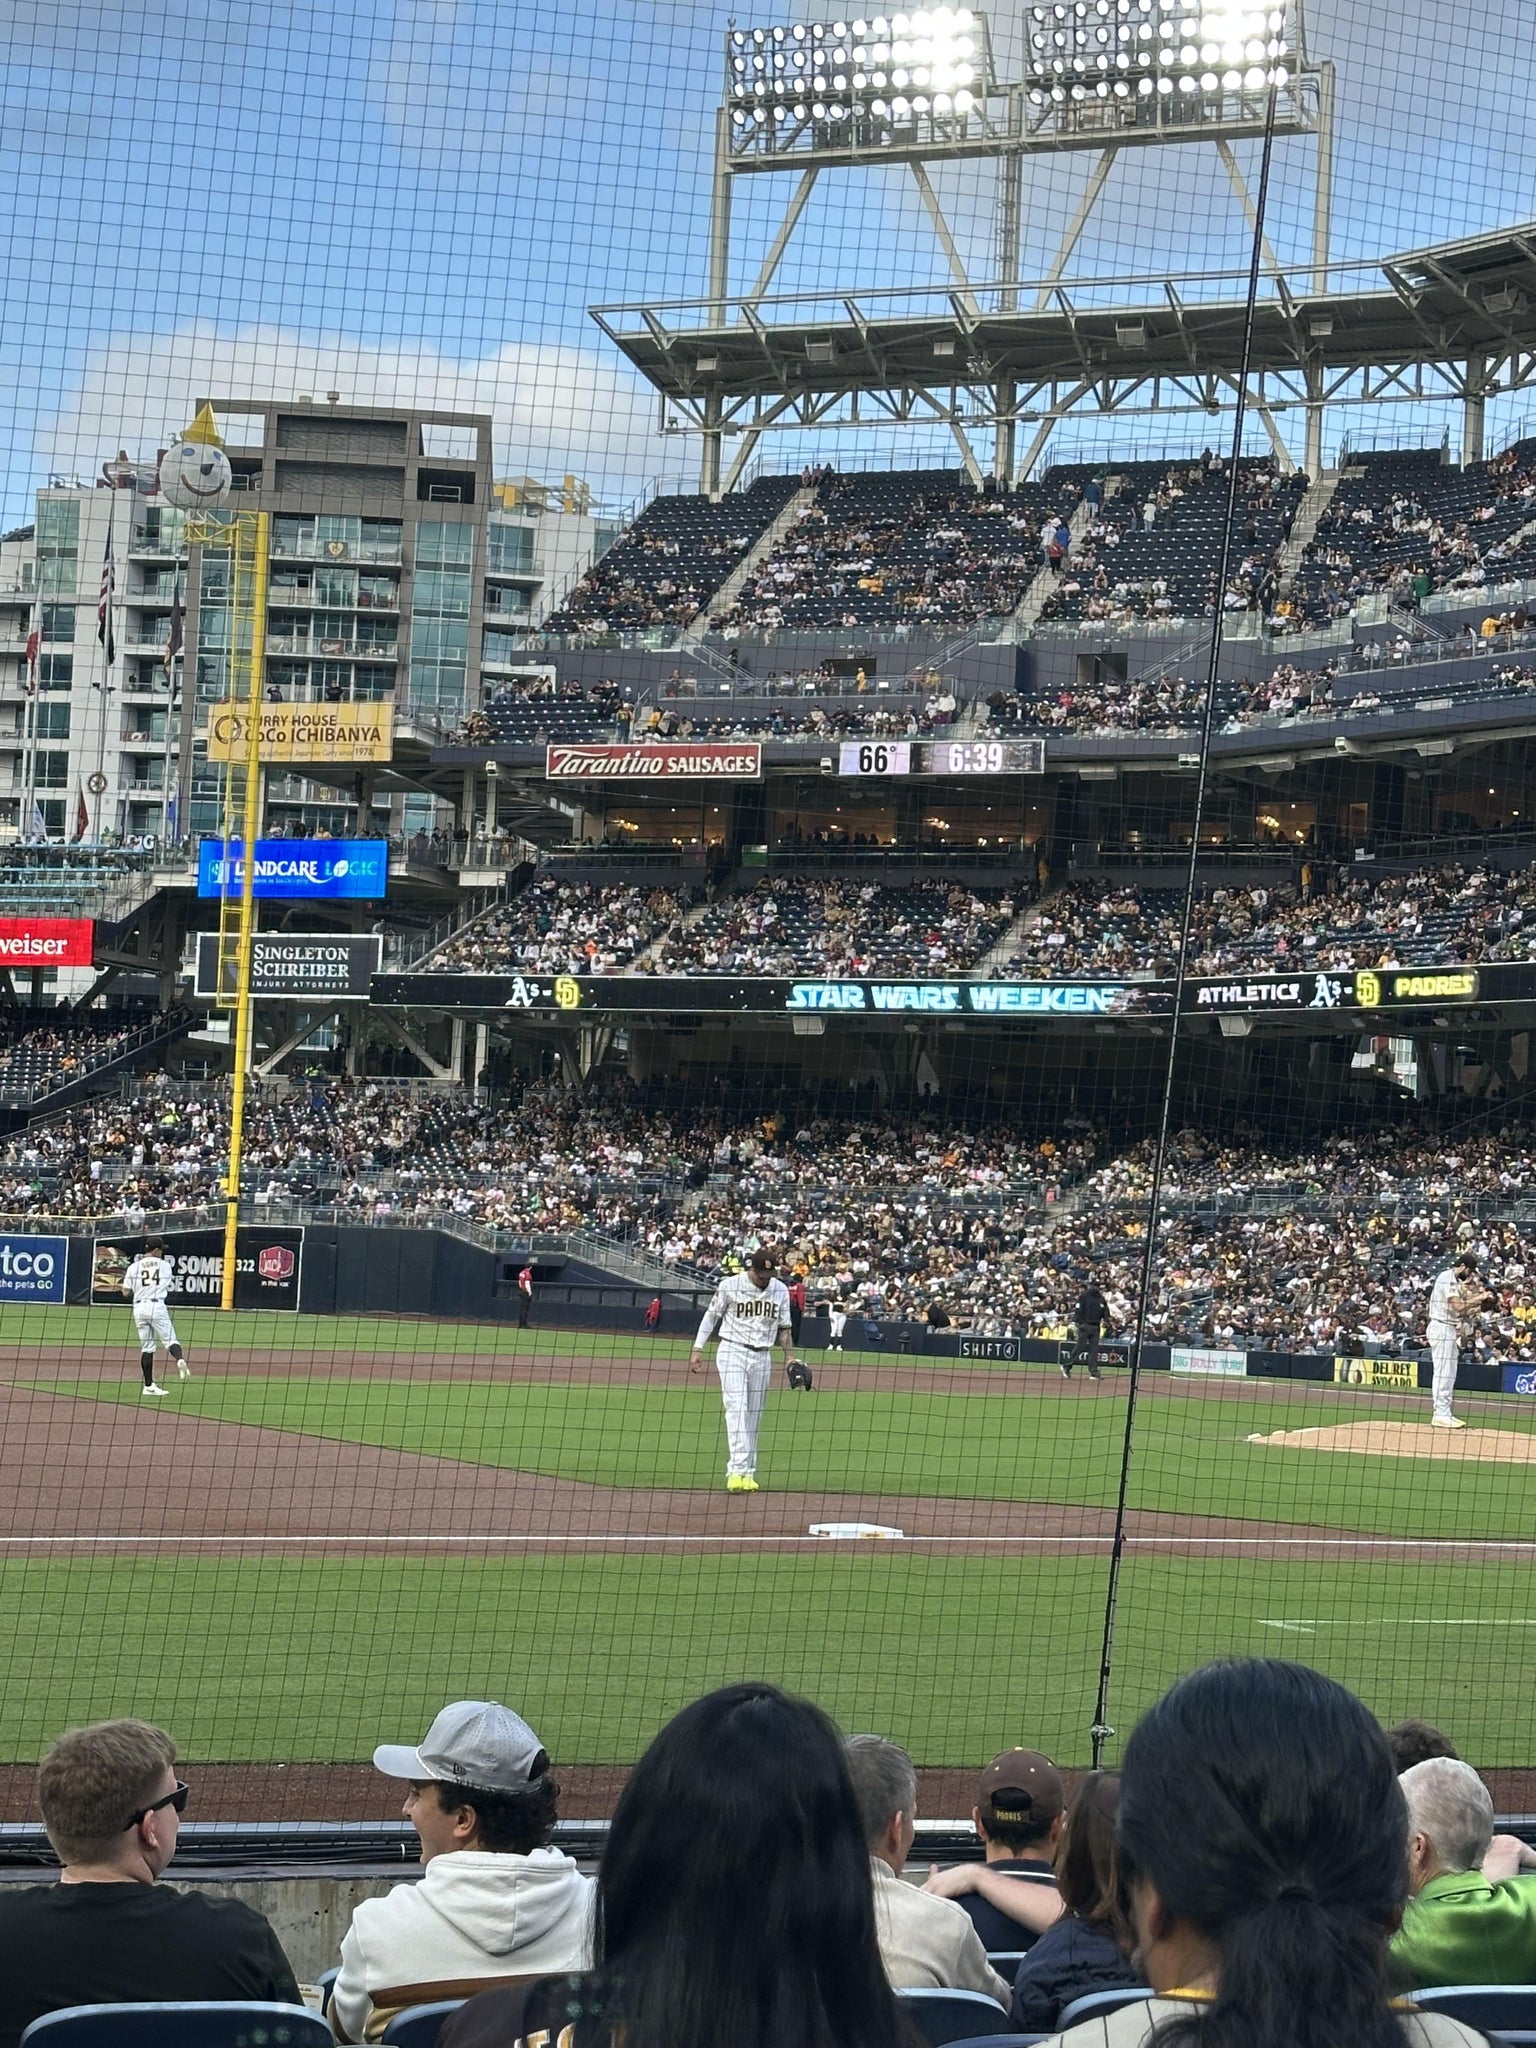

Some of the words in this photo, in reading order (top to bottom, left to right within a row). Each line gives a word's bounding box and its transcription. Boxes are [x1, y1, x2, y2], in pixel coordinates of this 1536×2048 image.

[292, 715, 336, 726] HOUSE
[291, 727, 381, 742] ICHIBANYA
[552, 749, 664, 775] Tarantino
[667, 756, 755, 773] SAUSAGES
[949, 743, 1002, 772] 6:39
[234, 860, 318, 877] LNDCARE
[253, 943, 350, 960] SINGLETON
[252, 961, 350, 978] SCHREIBER
[252, 980, 286, 988] INJURY
[293, 980, 350, 989] ATTORNEYS
[1197, 983, 1299, 1004] ATHLETICS
[1395, 974, 1474, 998] PADRES
[786, 984, 866, 1008] STAR
[178, 1255, 223, 1276] SOME
[236, 1259, 255, 1272] 322
[15, 1280, 35, 1290] pets
[37, 1279, 53, 1290] GO
[141, 1269, 160, 1287] 24
[185, 1275, 207, 1294] ON
[1373, 1361, 1390, 1374] DEL
[1393, 1362, 1411, 1375] REY
